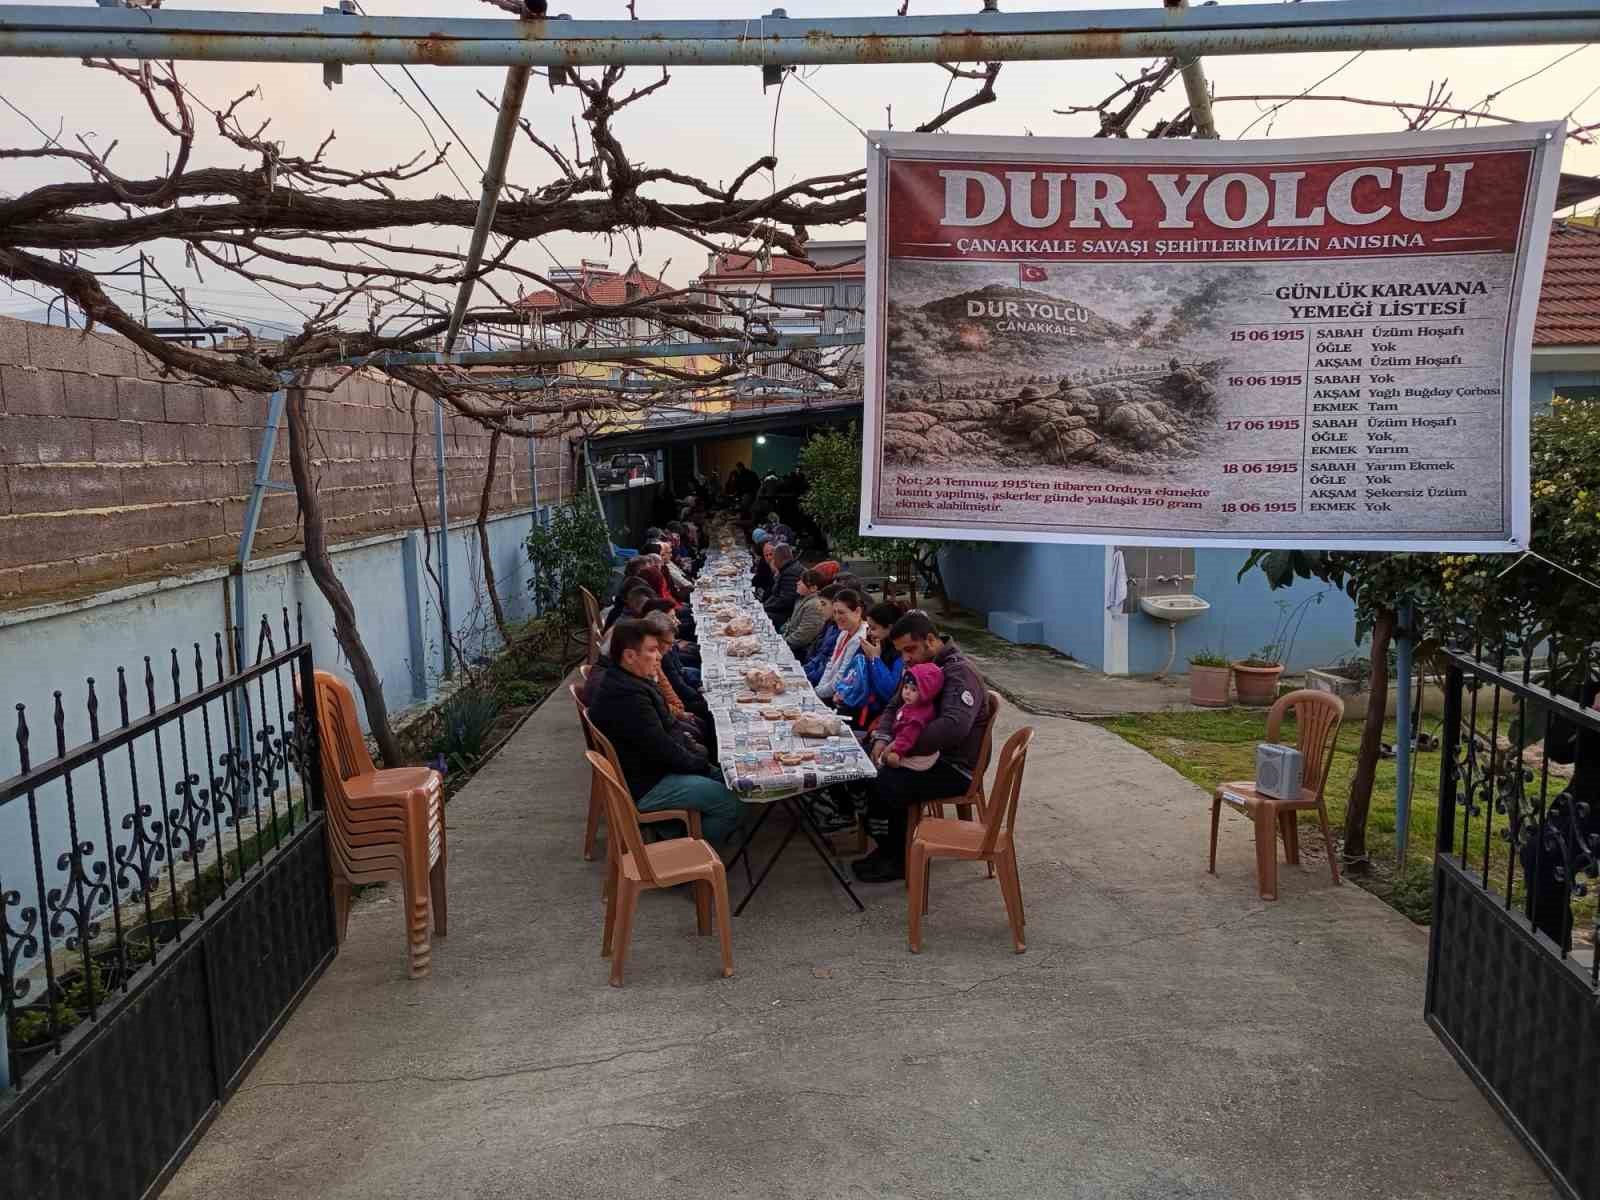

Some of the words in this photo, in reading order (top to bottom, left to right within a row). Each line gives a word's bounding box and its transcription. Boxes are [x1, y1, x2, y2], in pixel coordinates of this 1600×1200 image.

[938, 169, 1133, 230] DUR
[1148, 162, 1474, 230] YOLCU
[956, 238, 1076, 254] ÇANAKKALE
[1081, 239, 1148, 256] SAVAŞI
[1155, 237, 1321, 256] ŞEHİTLERİMİZİN
[1326, 233, 1425, 250] ANISINA
[1275, 283, 1367, 300] GÜNLÜK
[1372, 281, 1488, 298] KARAVANA
[967, 300, 1020, 318] DUR
[1025, 303, 1089, 324] YOLCU
[1290, 301, 1373, 318] YEMEĞİ
[1380, 298, 1468, 316] LİSTESİ
[1230, 330, 1246, 341] 15
[1248, 330, 1269, 341] 06
[1272, 329, 1305, 341] 1915
[1316, 329, 1363, 338] SABAH
[1372, 326, 1413, 337] Üzüm
[1417, 325, 1464, 340] Hoşafı
[1316, 342, 1352, 353] ÖĞLE
[1371, 342, 1397, 352] Yok
[1315, 358, 1362, 368] AKŞAM
[1370, 355, 1411, 366] Üzüm
[1415, 354, 1463, 367] Hoşafı
[1228, 376, 1243, 386] 16
[1246, 376, 1266, 386] 06
[1270, 375, 1302, 386] 1915
[1314, 375, 1360, 384] SABAH
[1369, 373, 1395, 383] Yok
[1313, 389, 1360, 400] AKŞAM
[1368, 388, 1401, 399] Yağlı
[1404, 387, 1453, 398] Buğday
[1313, 403, 1359, 412] EKMEK
[1367, 402, 1398, 411] Tam
[1225, 421, 1240, 430] 17
[1244, 420, 1264, 430] 06
[1268, 419, 1300, 430] 1915
[1312, 419, 1358, 428] SABAH
[1367, 416, 1407, 427] Üzüm
[1412, 416, 1457, 428] Hoşafı
[1311, 431, 1348, 441] ÖĞLE
[1366, 431, 1393, 441] Yok
[1312, 446, 1357, 455] EKMEK
[1366, 445, 1409, 454] Yarım
[1222, 464, 1238, 473] 18
[1242, 464, 1262, 473] 06
[1265, 463, 1298, 473] 1915
[1310, 462, 1357, 471] SABAH
[1365, 462, 1406, 471] Yarım
[1409, 461, 1455, 471] Ekmek
[896, 475, 923, 486] Not:
[926, 477, 940, 486] 24
[943, 478, 999, 488] Temmuz
[1001, 480, 1050, 490] 1915'ten
[1053, 481, 1102, 492] itibaren
[1105, 483, 1152, 496] Orduya
[1155, 487, 1210, 498] ekmekte
[1310, 474, 1346, 485] ÖĞLE
[1365, 474, 1392, 485] Yok
[992, 491, 1042, 502] askerler
[1044, 493, 1084, 504] günde
[1142, 498, 1164, 506] 150
[1167, 500, 1203, 509] gram
[1309, 489, 1357, 500] AKŞAM
[1365, 488, 1424, 499] Şekersiz
[1427, 486, 1468, 497] Üzüm
[895, 500, 936, 510] ekmek
[1221, 503, 1237, 513] 18
[1240, 503, 1260, 513] 06
[1264, 502, 1297, 512] 1915
[1310, 503, 1357, 511] EKMEK
[1364, 502, 1392, 512] Yok
